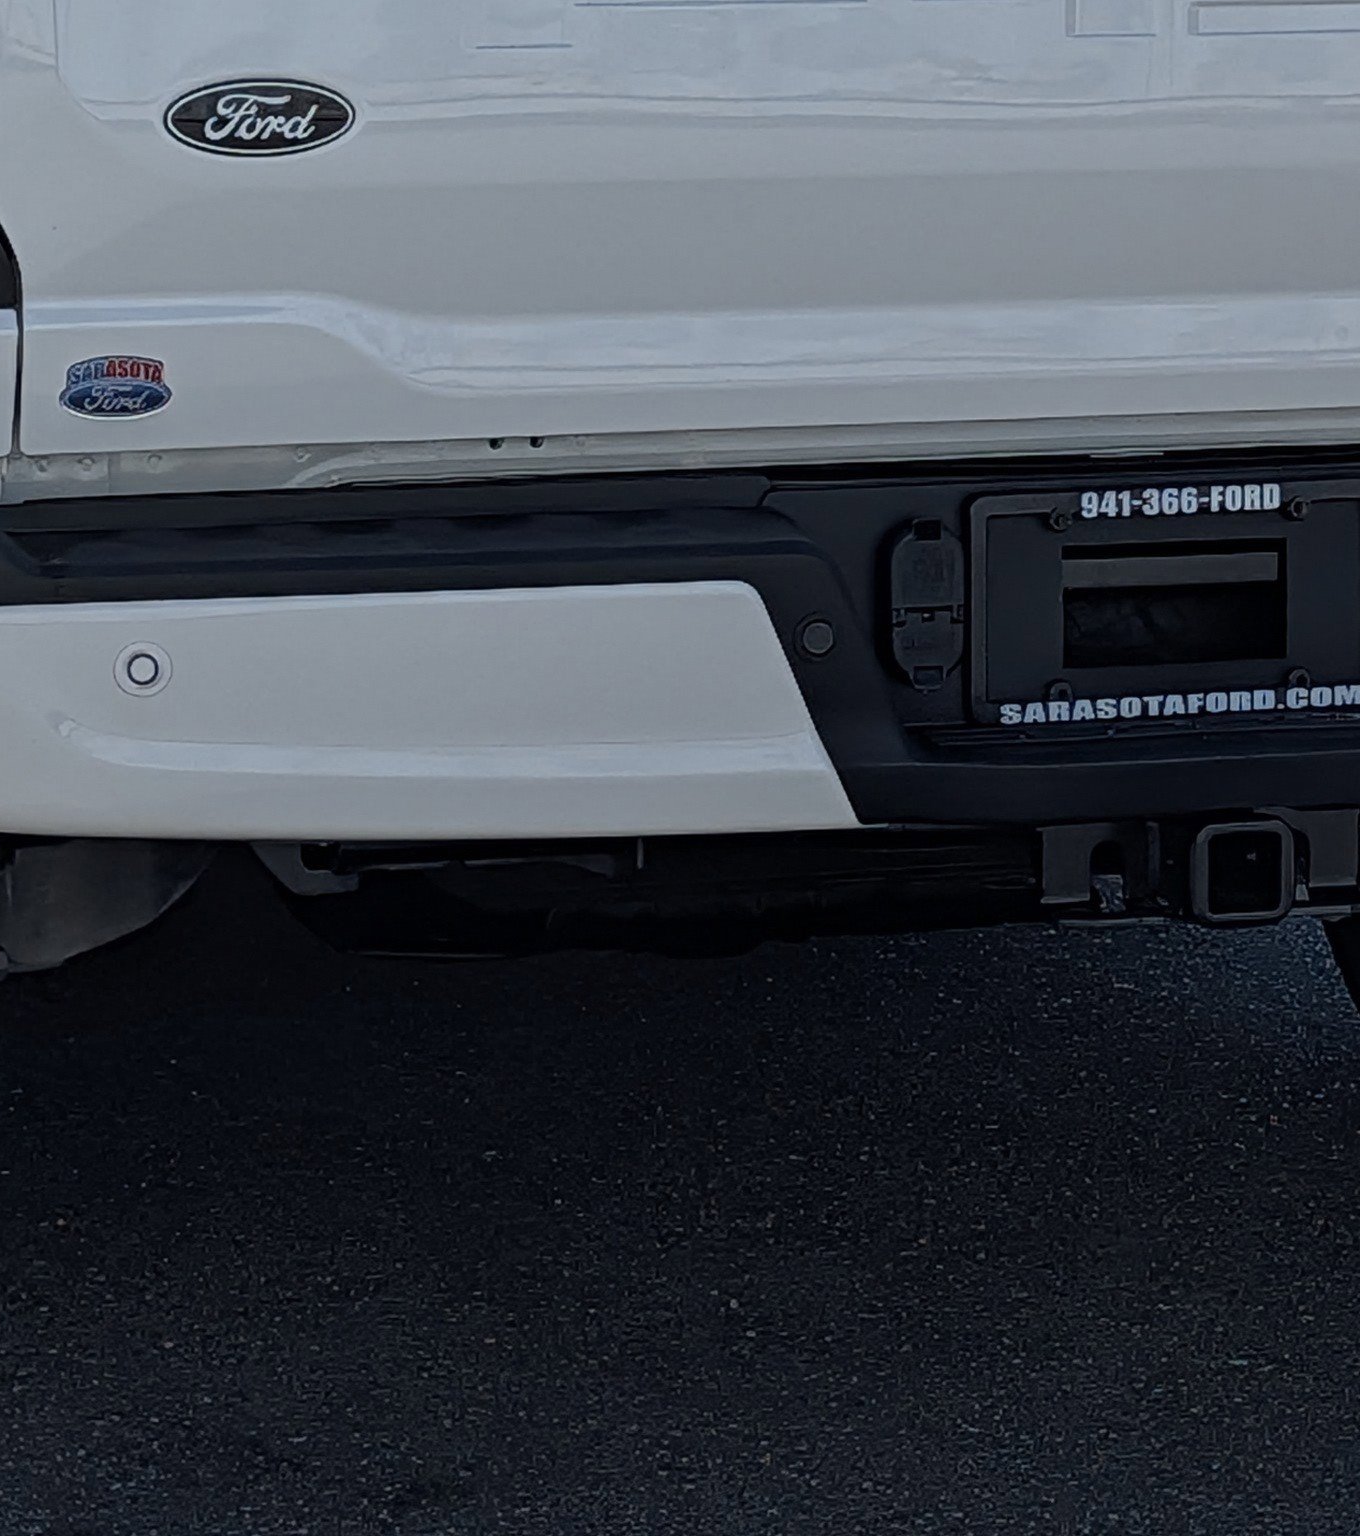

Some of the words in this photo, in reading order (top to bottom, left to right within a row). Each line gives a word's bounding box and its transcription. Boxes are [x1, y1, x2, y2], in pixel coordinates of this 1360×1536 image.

[204, 94, 317, 140] Ford
[68, 357, 164, 385] SARASOTA
[83, 385, 149, 411] Ford
[1080, 482, 1282, 519] 941-366-FORD
